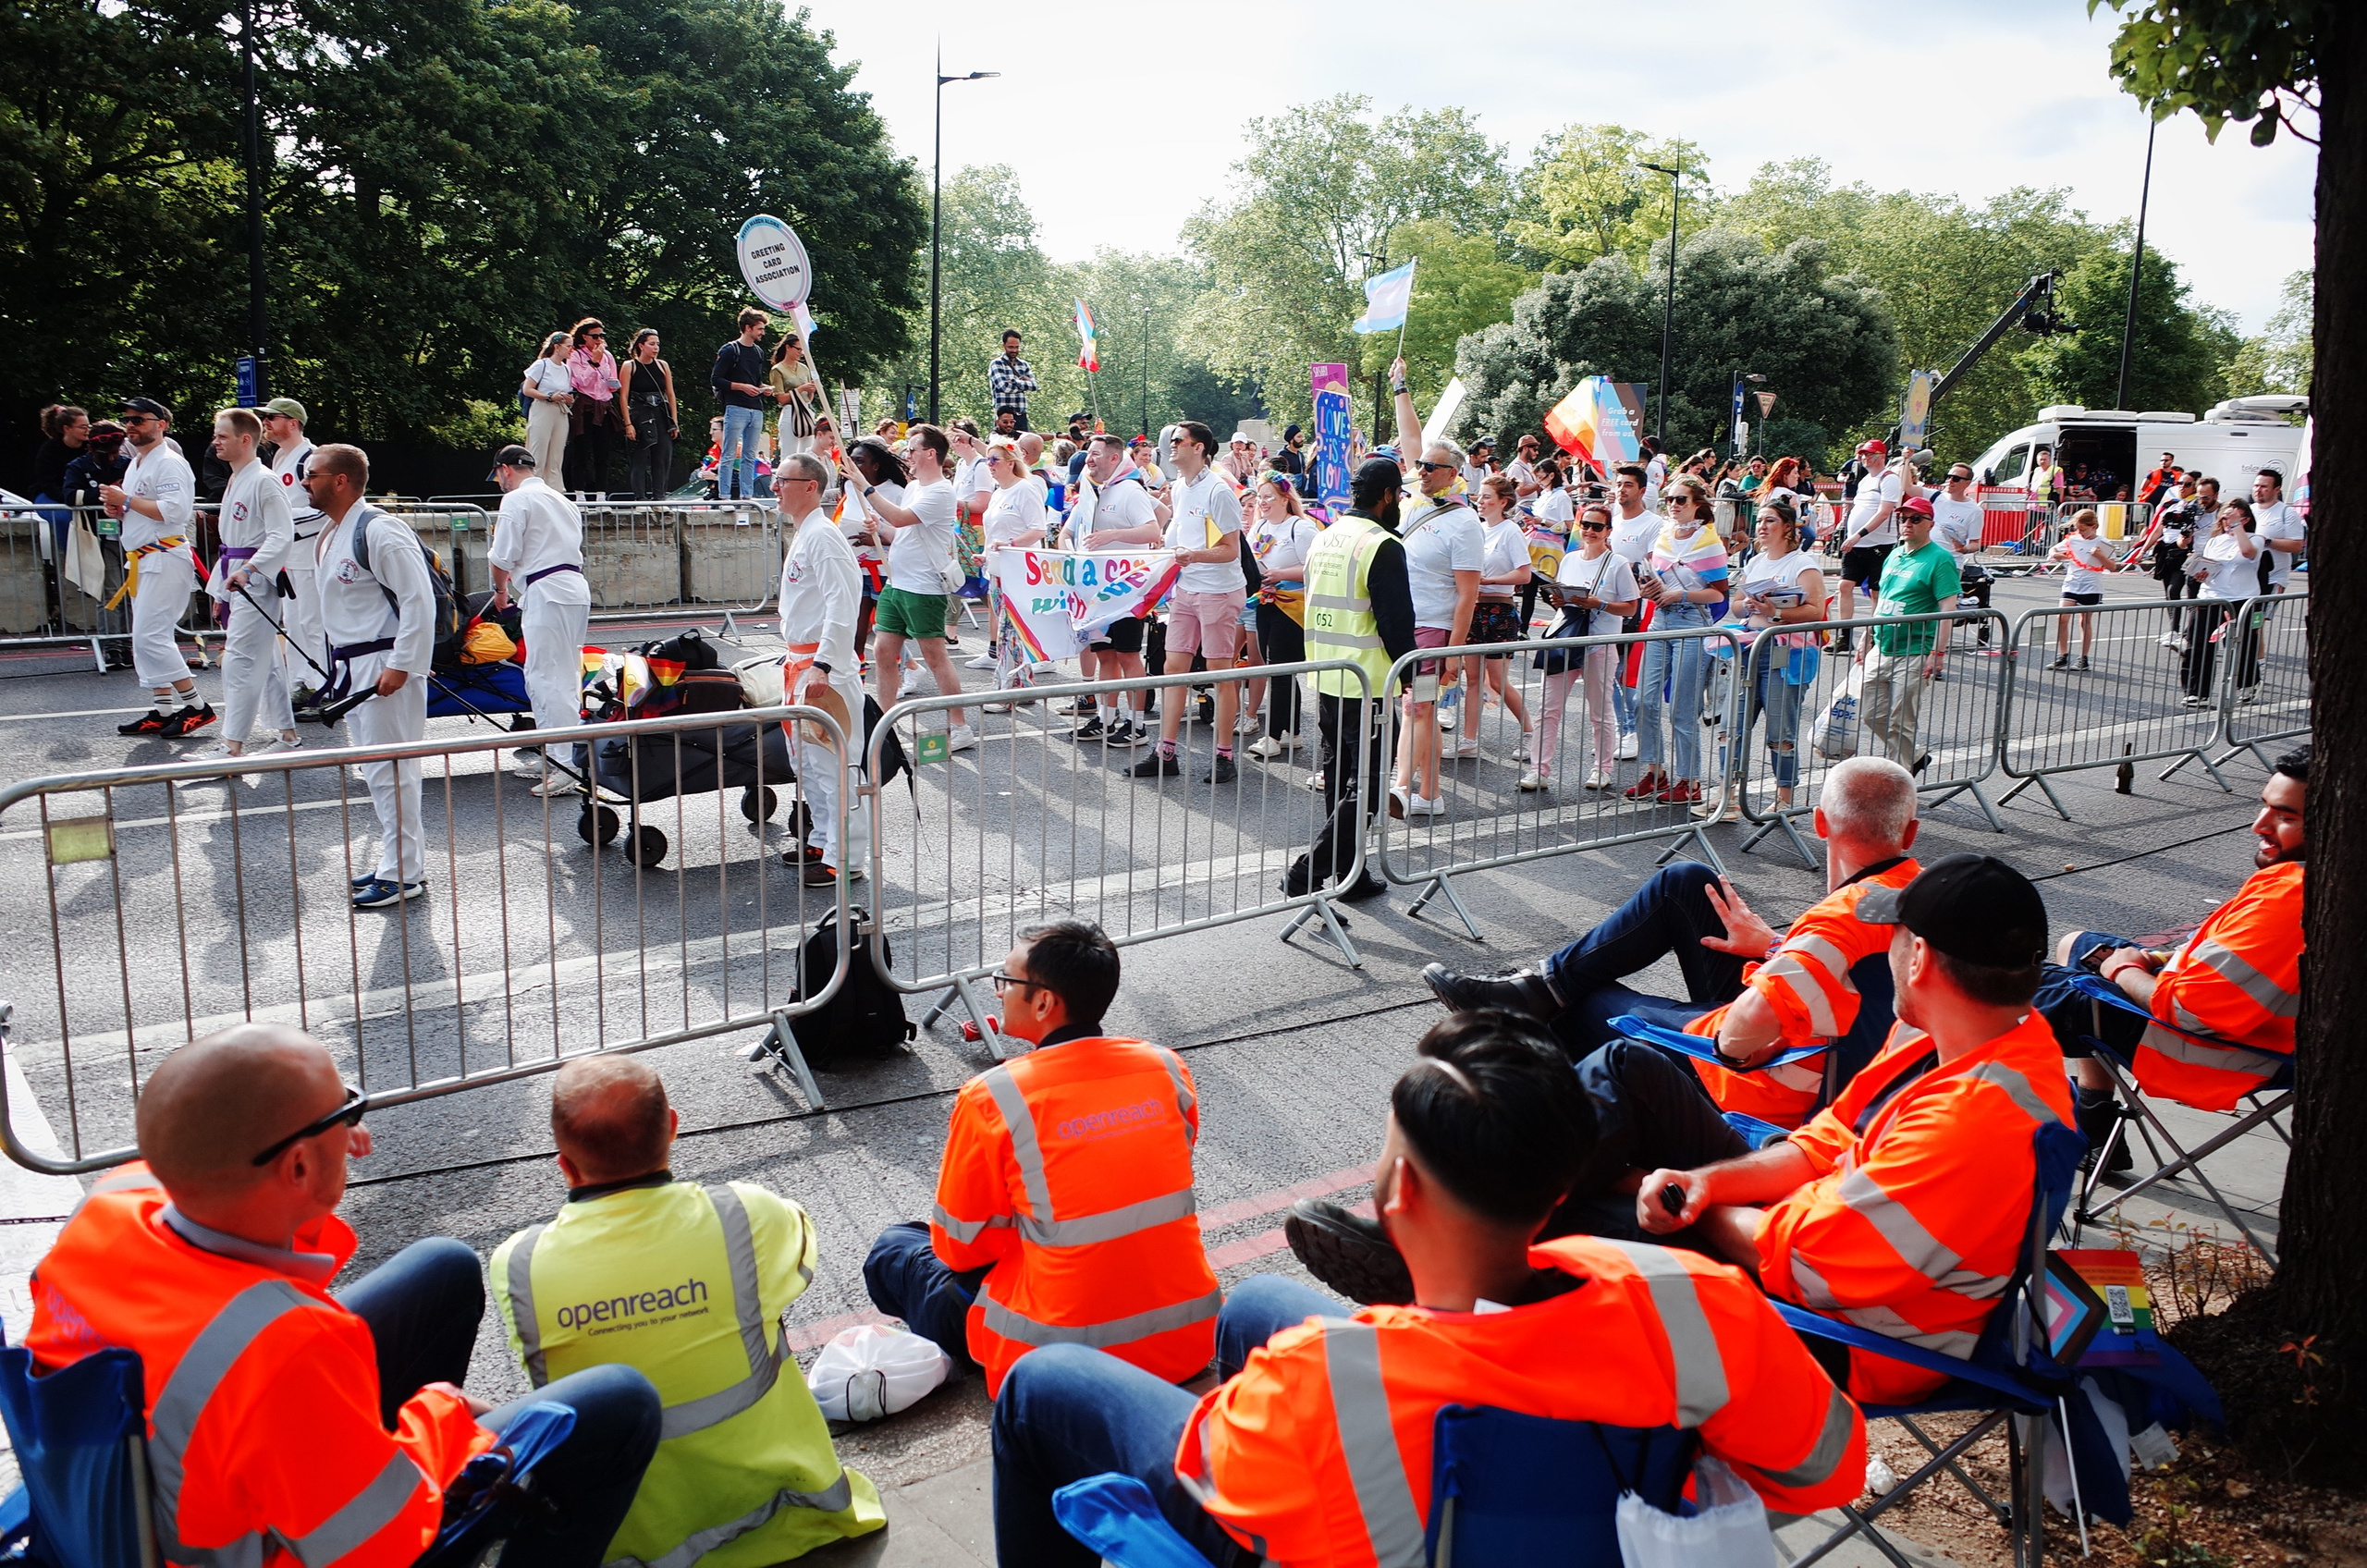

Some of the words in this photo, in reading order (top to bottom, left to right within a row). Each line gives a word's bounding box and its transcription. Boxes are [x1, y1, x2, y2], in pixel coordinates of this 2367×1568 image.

[751, 242, 786, 260] GREETING
[763, 257, 782, 269] CARD
[754, 264, 801, 285] ASSOCIATION
[1319, 406, 1347, 439] LOVE
[1601, 418, 1619, 426] FREE
[1620, 418, 1639, 426] card
[1608, 407, 1628, 415] Grab
[1601, 428, 1621, 436] from
[1319, 460, 1347, 496] LOVE
[1025, 551, 1076, 587] Send
[1082, 559, 1098, 587] a
[1032, 589, 1088, 620] with
[1316, 613, 1333, 628] 052
[1057, 1096, 1165, 1140] openreach
[557, 1278, 708, 1331] openreach
[587, 1322, 633, 1337] Connecting
[633, 1320, 648, 1330] you
[649, 1317, 659, 1326] to
[659, 1314, 678, 1325] your
[678, 1305, 710, 1319] network
